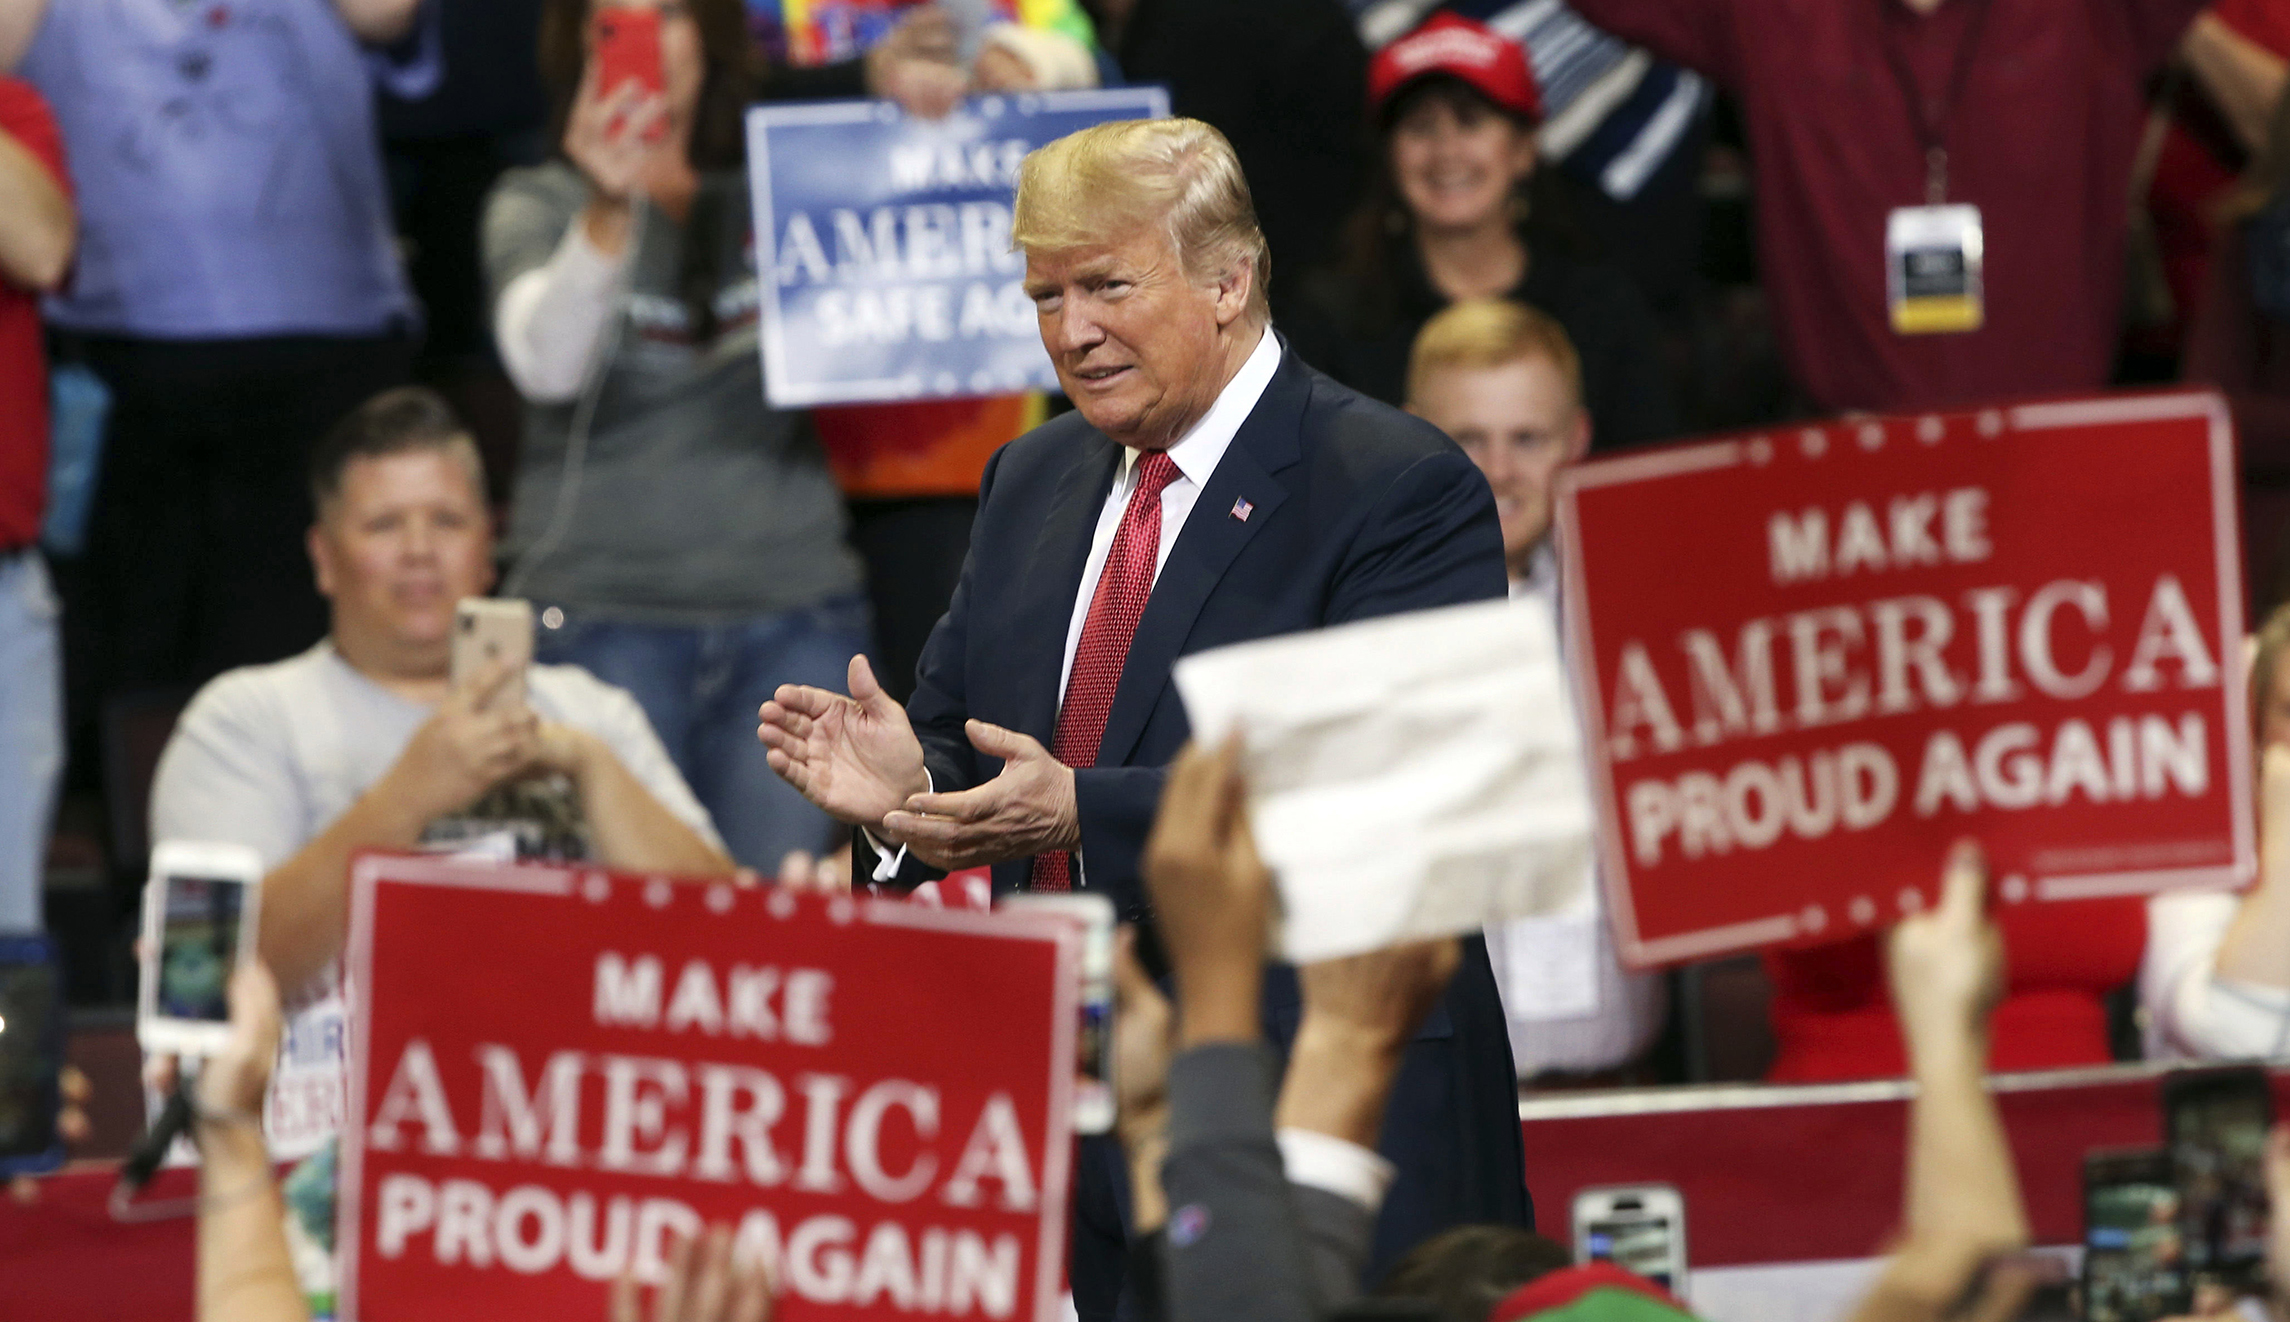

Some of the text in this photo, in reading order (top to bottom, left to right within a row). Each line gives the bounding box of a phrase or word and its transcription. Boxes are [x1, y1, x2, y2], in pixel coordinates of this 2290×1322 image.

[773, 200, 1025, 286] AMER
[813, 283, 951, 348] SAFE
[1767, 486, 1993, 585] MAKE
[1606, 572, 2223, 763] AMERICA
[1627, 711, 2209, 869] PROUD AGAIN
[592, 949, 836, 1048] MAKE
[369, 1034, 1038, 1214] AMERICA
